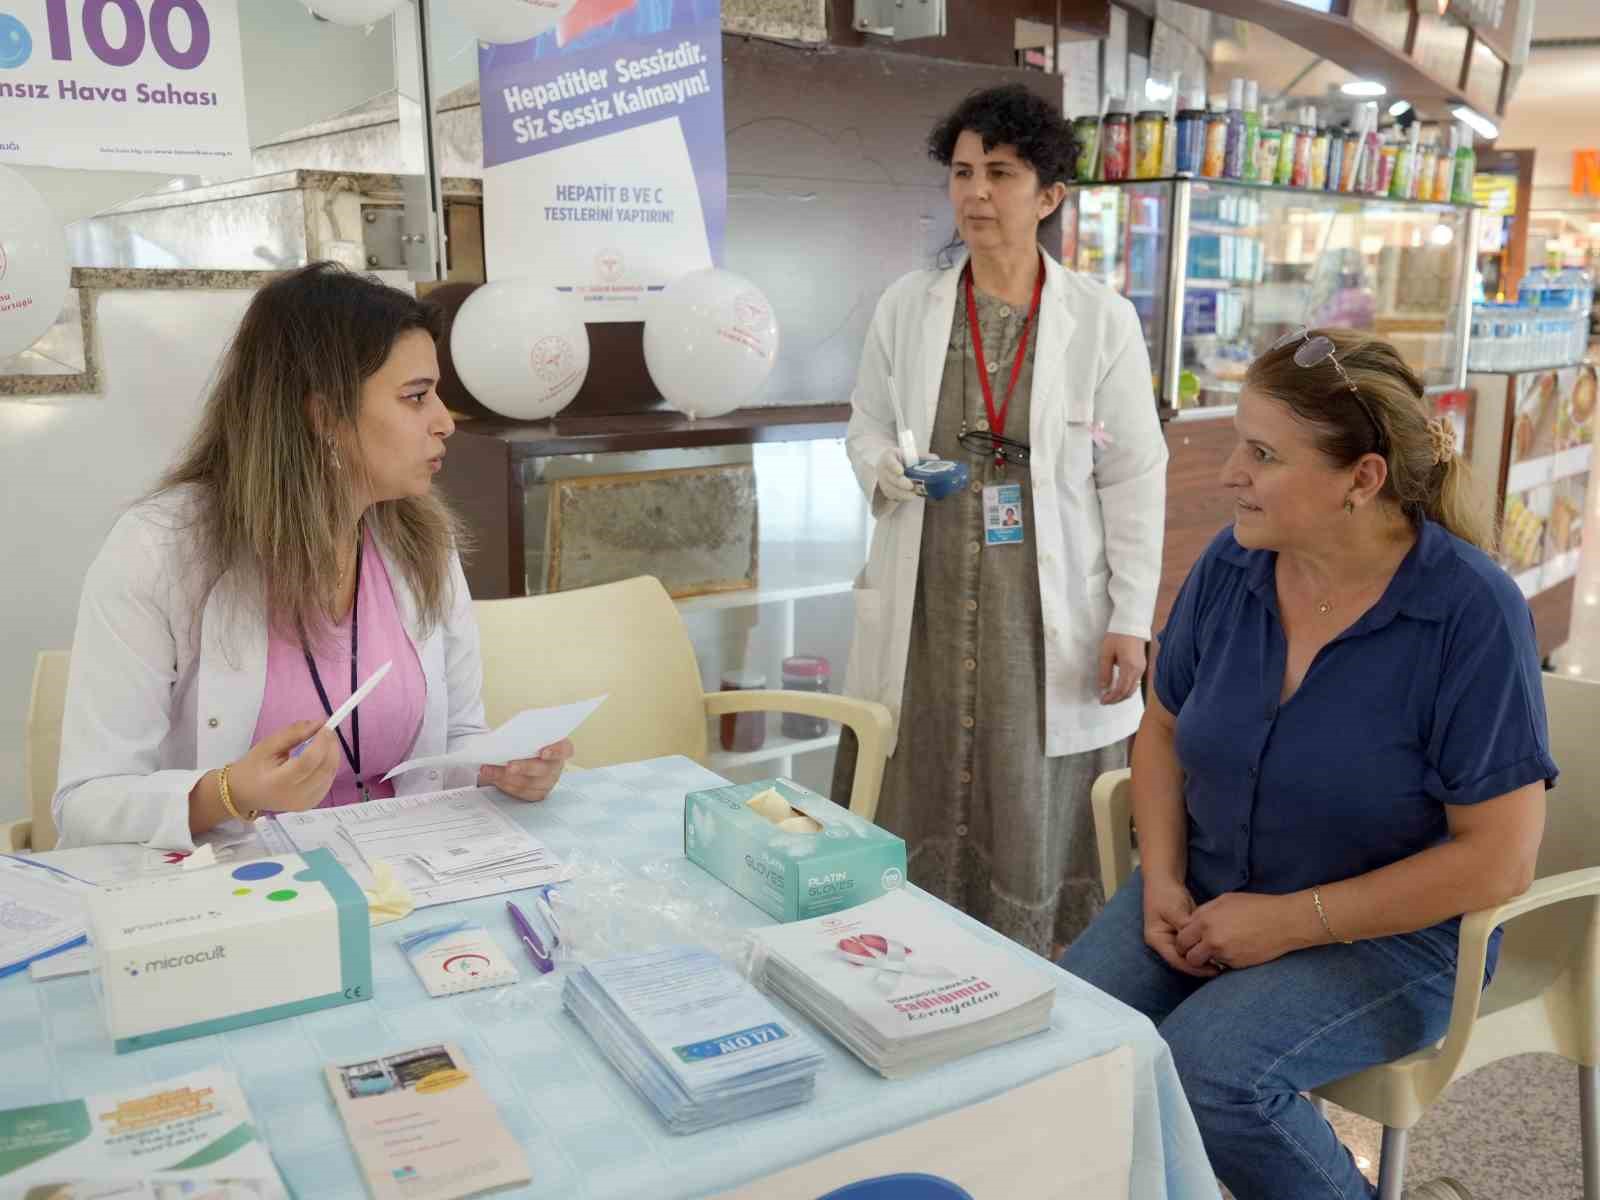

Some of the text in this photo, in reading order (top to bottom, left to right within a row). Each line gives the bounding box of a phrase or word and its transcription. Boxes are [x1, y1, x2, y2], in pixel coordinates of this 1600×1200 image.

[503, 41, 708, 113] Hepatitler Sessizdir.
[58, 80, 127, 103] Hava
[136, 83, 217, 106] Sahası
[512, 70, 710, 145] Siz Sessiz Kalmayın!
[556, 183, 664, 204] HEPATİT B VE C
[544, 206, 675, 224] TESTLERİNİ YAPTIRIN!
